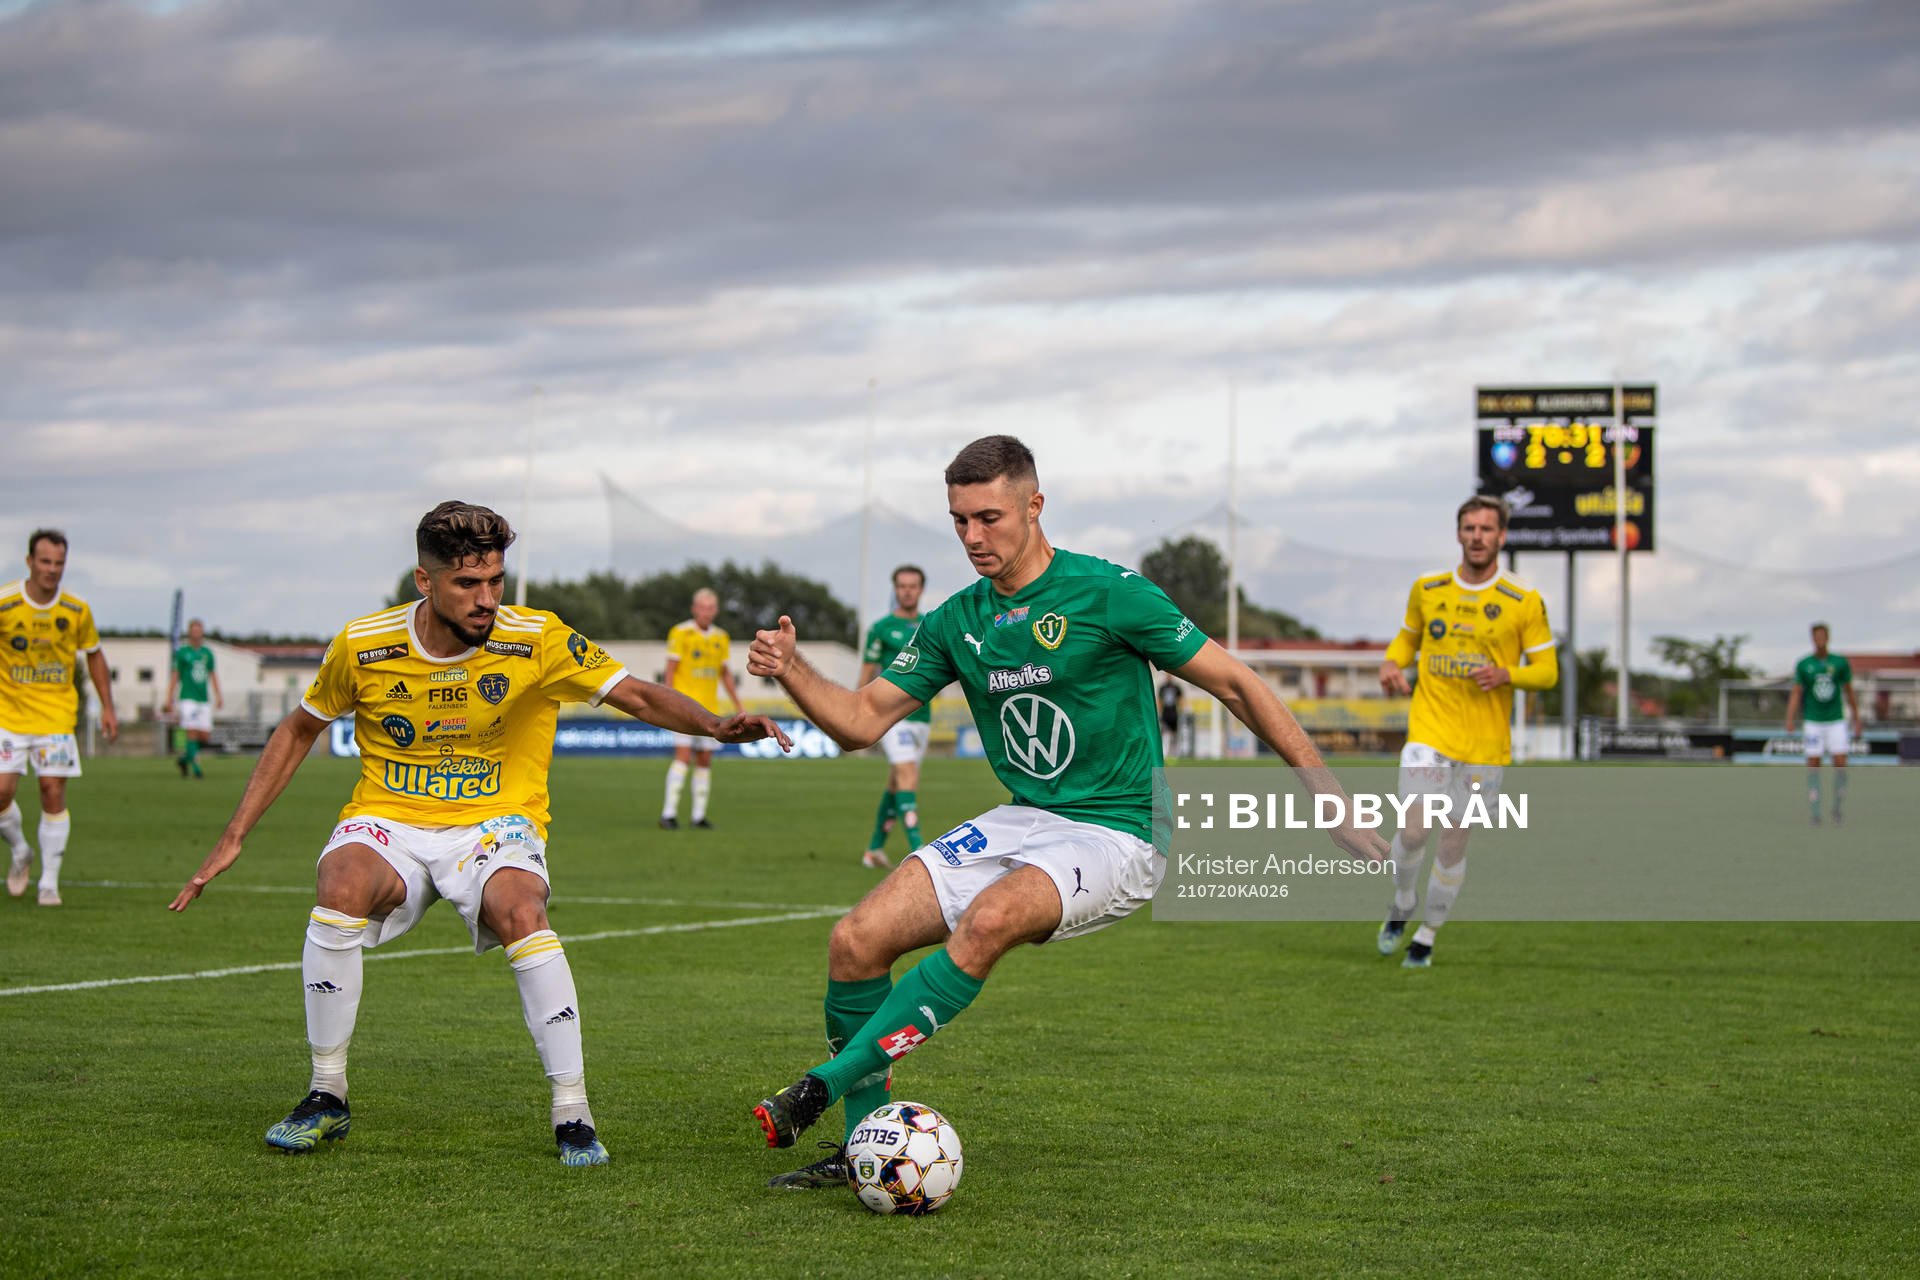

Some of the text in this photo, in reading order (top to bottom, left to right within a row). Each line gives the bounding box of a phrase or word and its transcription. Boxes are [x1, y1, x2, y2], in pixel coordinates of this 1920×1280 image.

[486, 640, 532, 653] HUSCENTRUM
[359, 652, 369, 660] PB
[370, 648, 388, 658] BYGG
[430, 670, 469, 682] Ullared
[989, 663, 1051, 692] Atteviks
[386, 692, 413, 700] adidas
[428, 687, 468, 702] FBG
[442, 718, 467, 726] INTER
[435, 757, 490, 775] Gekås
[384, 759, 501, 800] Ullared
[850, 1128, 900, 1146] SELECT
